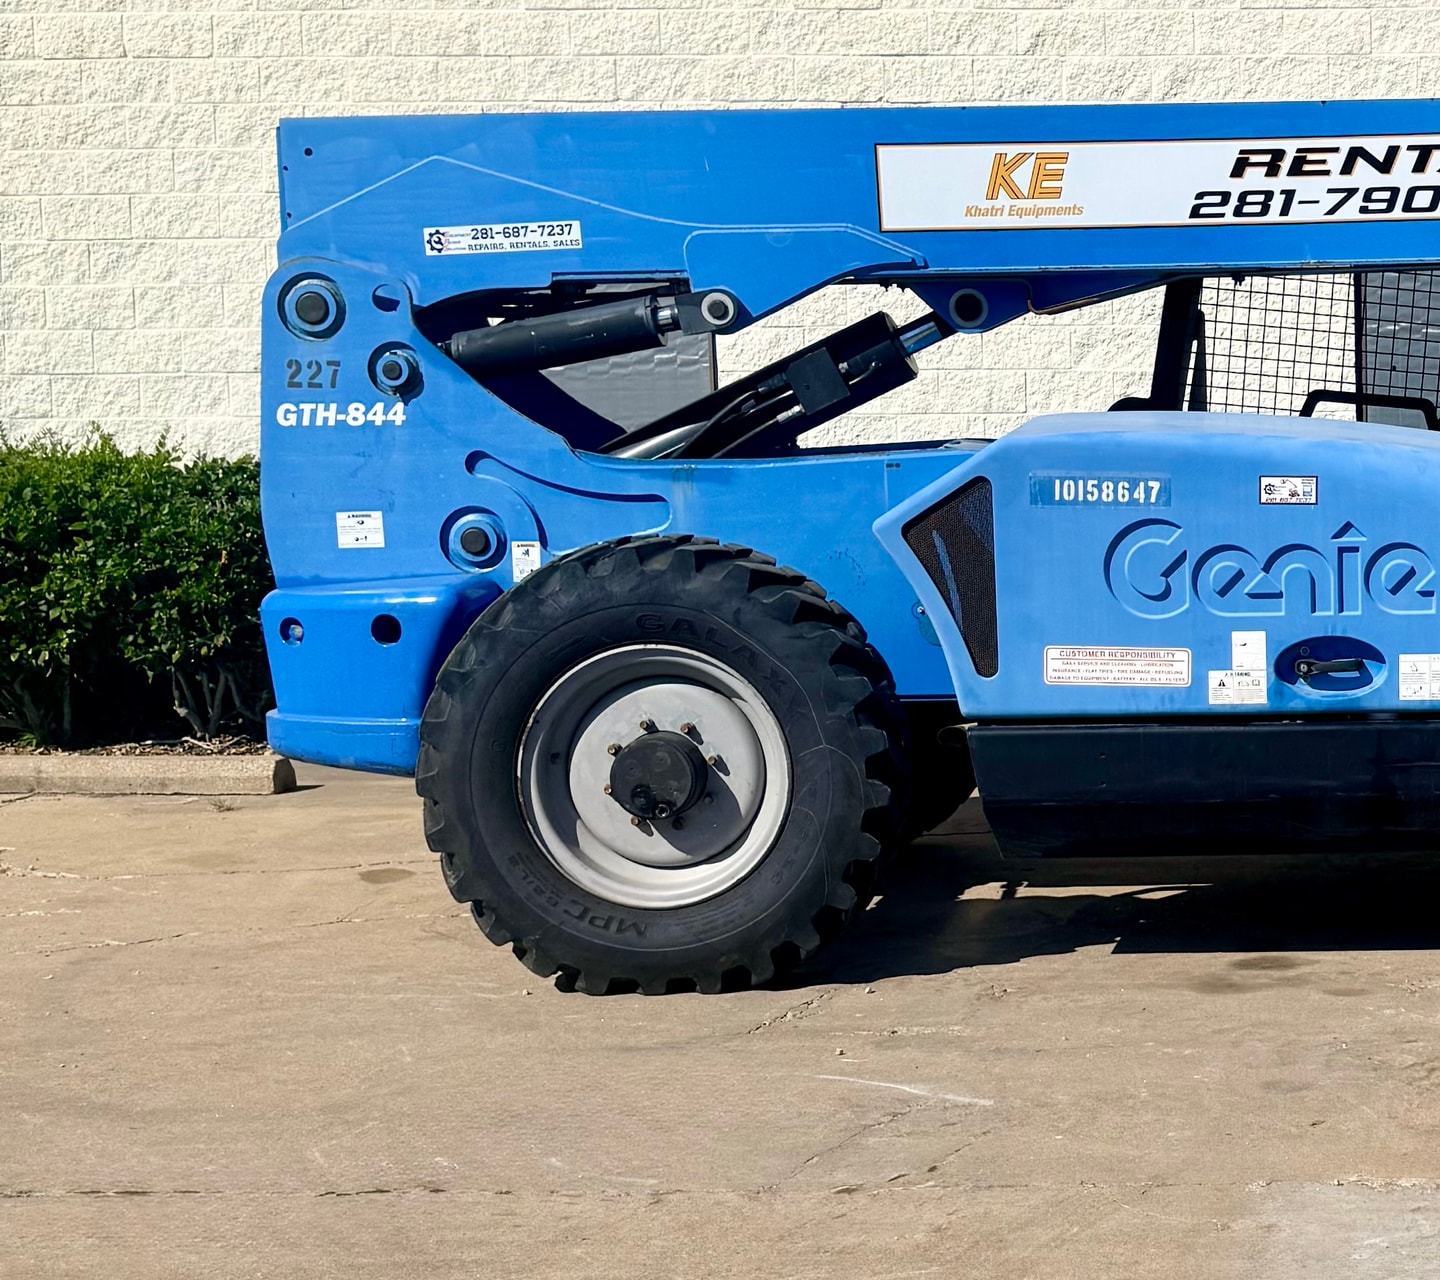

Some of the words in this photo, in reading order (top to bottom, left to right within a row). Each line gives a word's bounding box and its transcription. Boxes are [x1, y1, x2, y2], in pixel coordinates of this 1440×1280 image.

[986, 152, 1069, 200] KE
[965, 205, 1005, 218] Khatri
[1008, 204, 1084, 218] Equipments
[470, 224, 573, 240] 281-687-7237
[553, 239, 580, 247] SALES
[286, 359, 341, 389] 227
[276, 402, 406, 427] GTH-844
[1054, 479, 1160, 503] 10158647
[1103, 517, 1437, 620] Genie
[1108, 651, 1176, 659] RESPONSIBILITY
